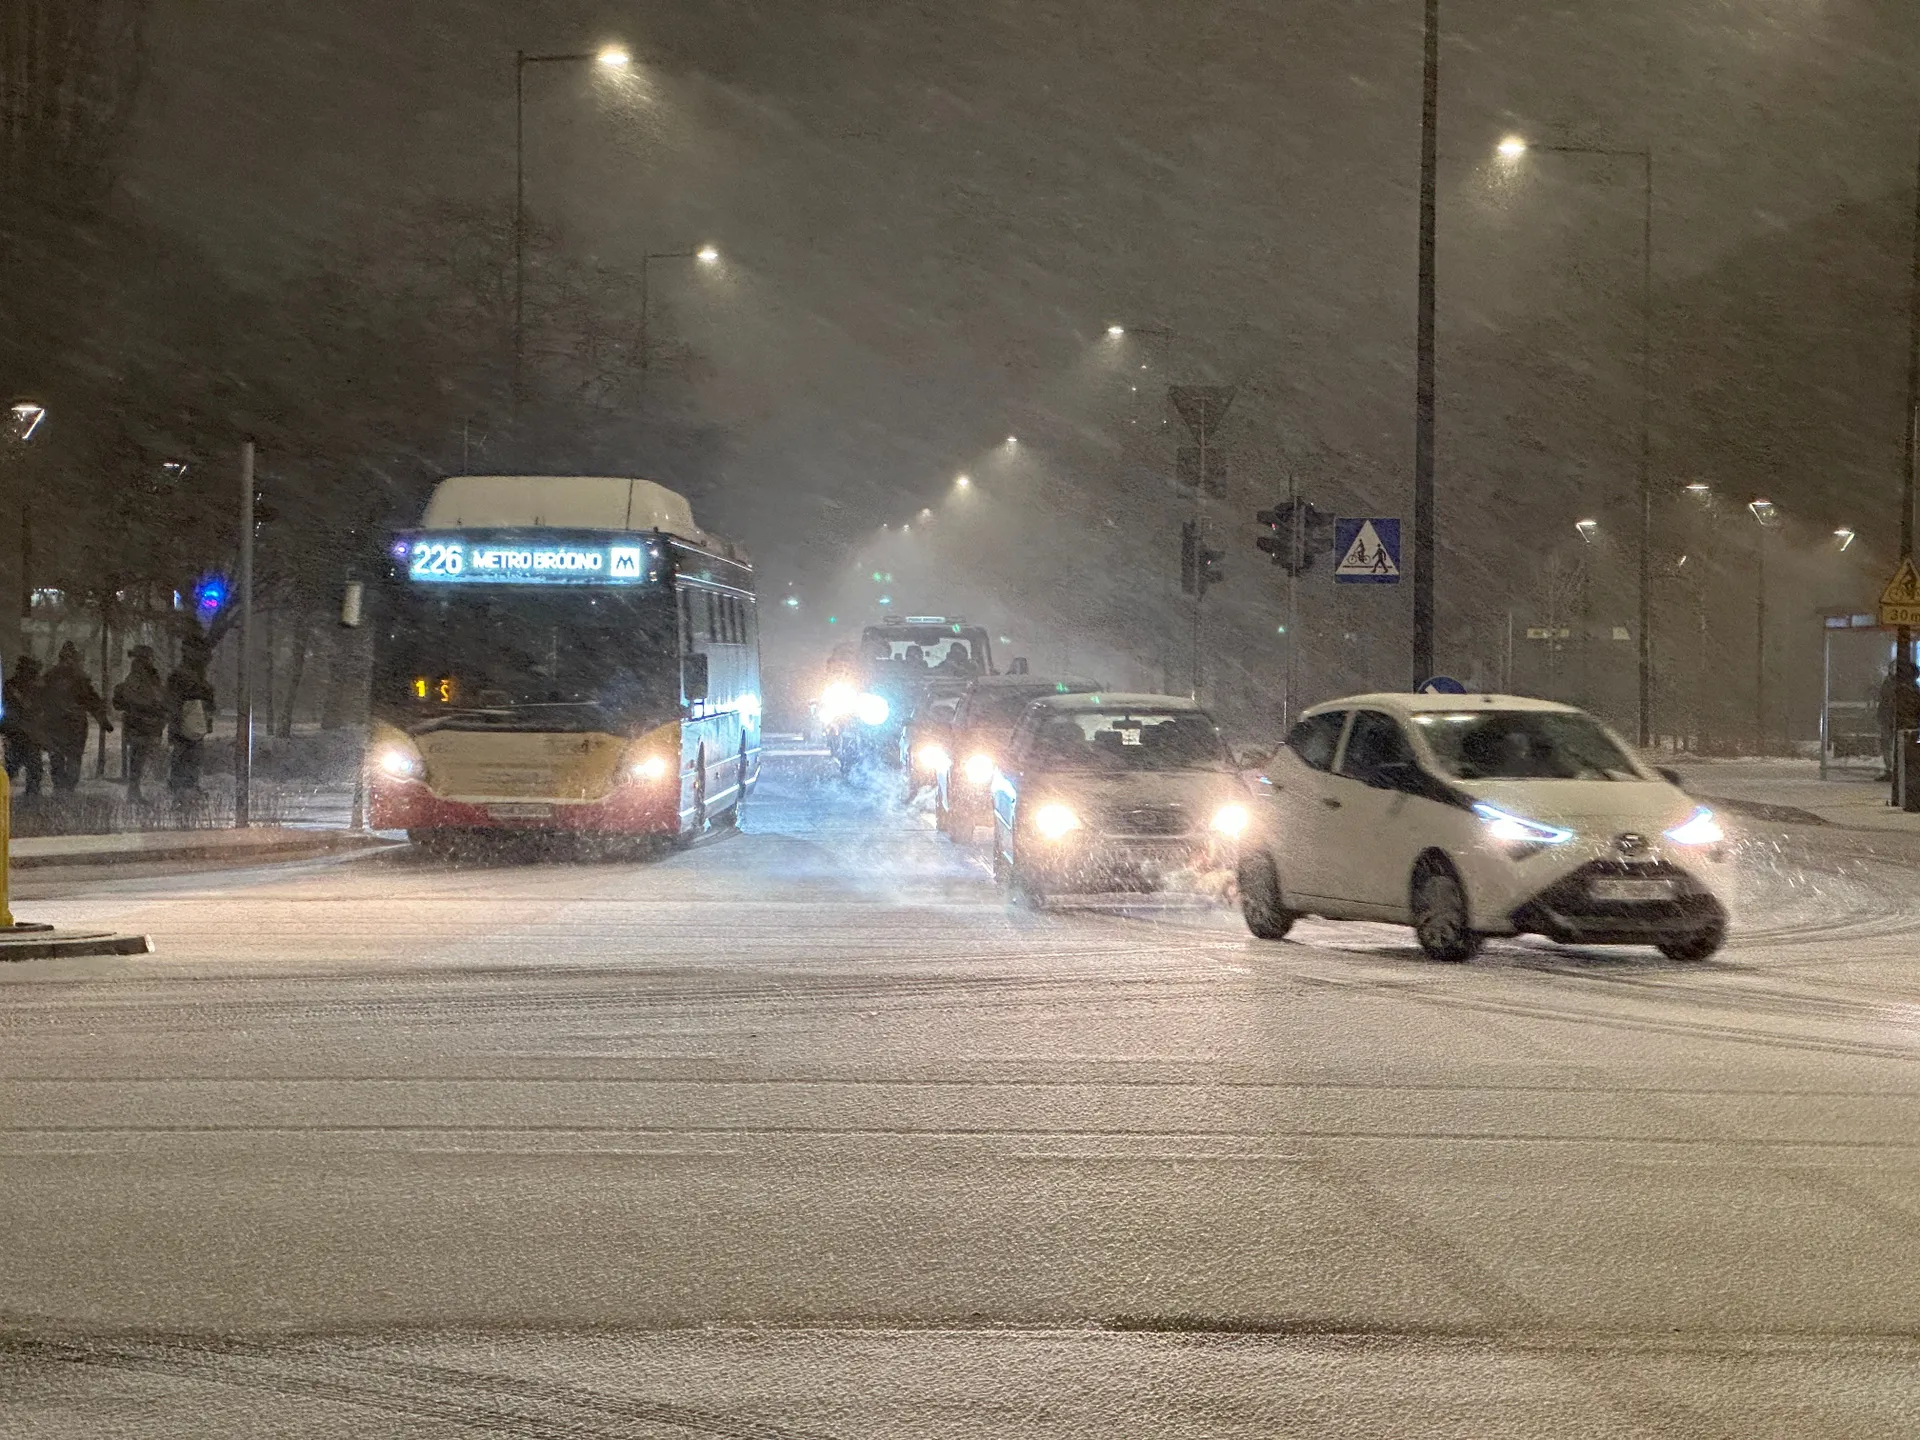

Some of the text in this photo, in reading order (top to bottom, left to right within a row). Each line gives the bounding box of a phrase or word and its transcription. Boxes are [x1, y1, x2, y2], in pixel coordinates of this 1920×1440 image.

[413, 544, 462, 574] 226
[473, 551, 531, 568] METRO
[533, 549, 602, 569] BRÓDNO
[1890, 609, 1908, 620] 30
